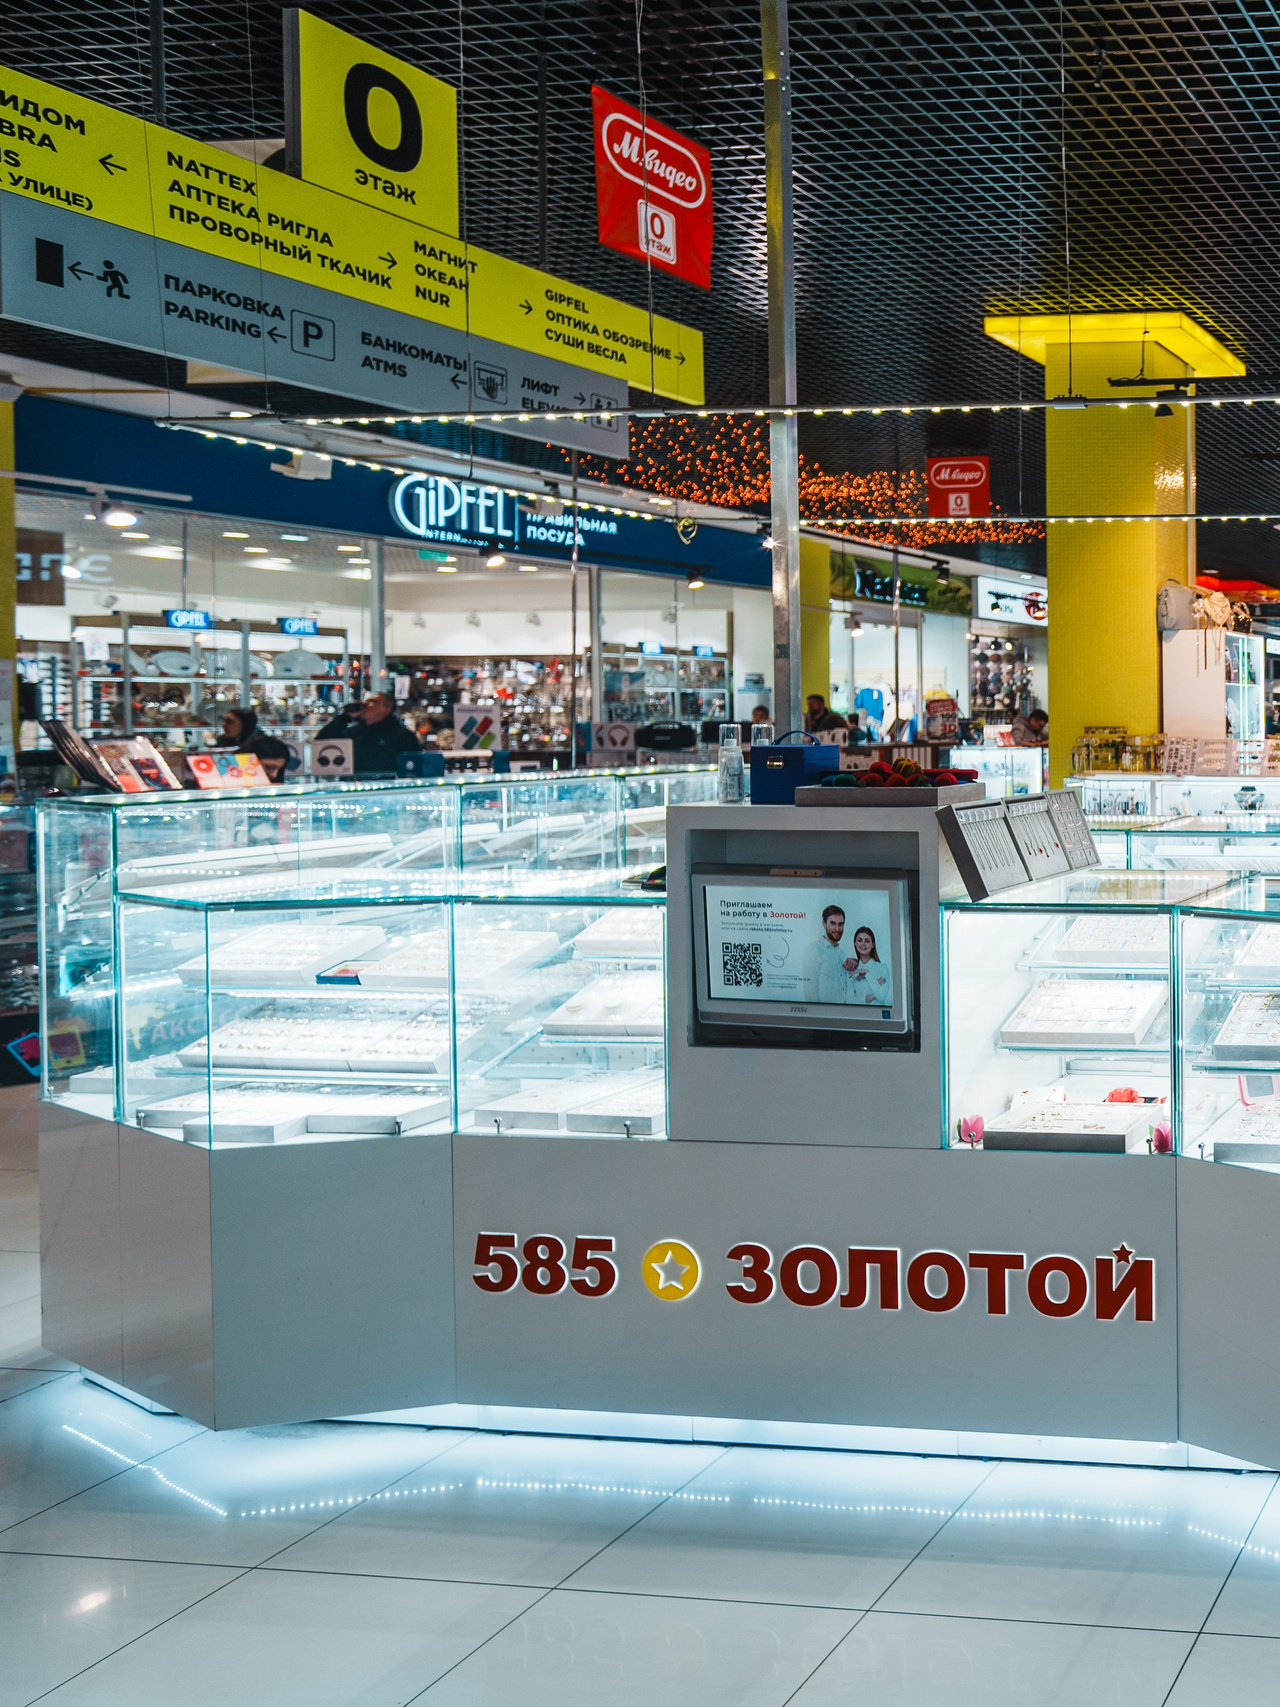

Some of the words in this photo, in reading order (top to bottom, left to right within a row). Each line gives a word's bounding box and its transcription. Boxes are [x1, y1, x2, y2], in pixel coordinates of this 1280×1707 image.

[8, 171, 94, 211] УЛИЦЕ)
[166, 151, 258, 196] NATTEX
[354, 168, 418, 205] этаж
[168, 179, 262, 222] АПТЕКА
[267, 213, 334, 247] РИГЛА
[169, 204, 312, 263] ПРОВОРНЫЙ
[317, 253, 392, 289] ТКАЧИК
[413, 240, 478, 274] МАГНИТ
[414, 264, 469, 291] ОКЕАН
[164, 274, 286, 321] ПАРКОВКА
[415, 285, 451, 308] NUR
[544, 289, 590, 315] GIPFEL
[164, 301, 262, 338] PARKING
[545, 310, 600, 336] ОПТИКА
[602, 328, 672, 361] ОБОЗРЕНИЕ
[361, 331, 468, 372] БАНКОМАТЫ
[544, 328, 585, 351] СУШИ
[587, 342, 627, 365] ВЕСЛА
[361, 356, 408, 378] ATMS
[521, 376, 560, 397] ЛИФТ
[720, 900, 773, 909] Приглашаем
[732, 910, 761, 919] работу
[770, 911, 806, 919] Золотой!
[471, 1230, 619, 1298] 585
[725, 1241, 1157, 1323] ЗОЛОТОЙ
